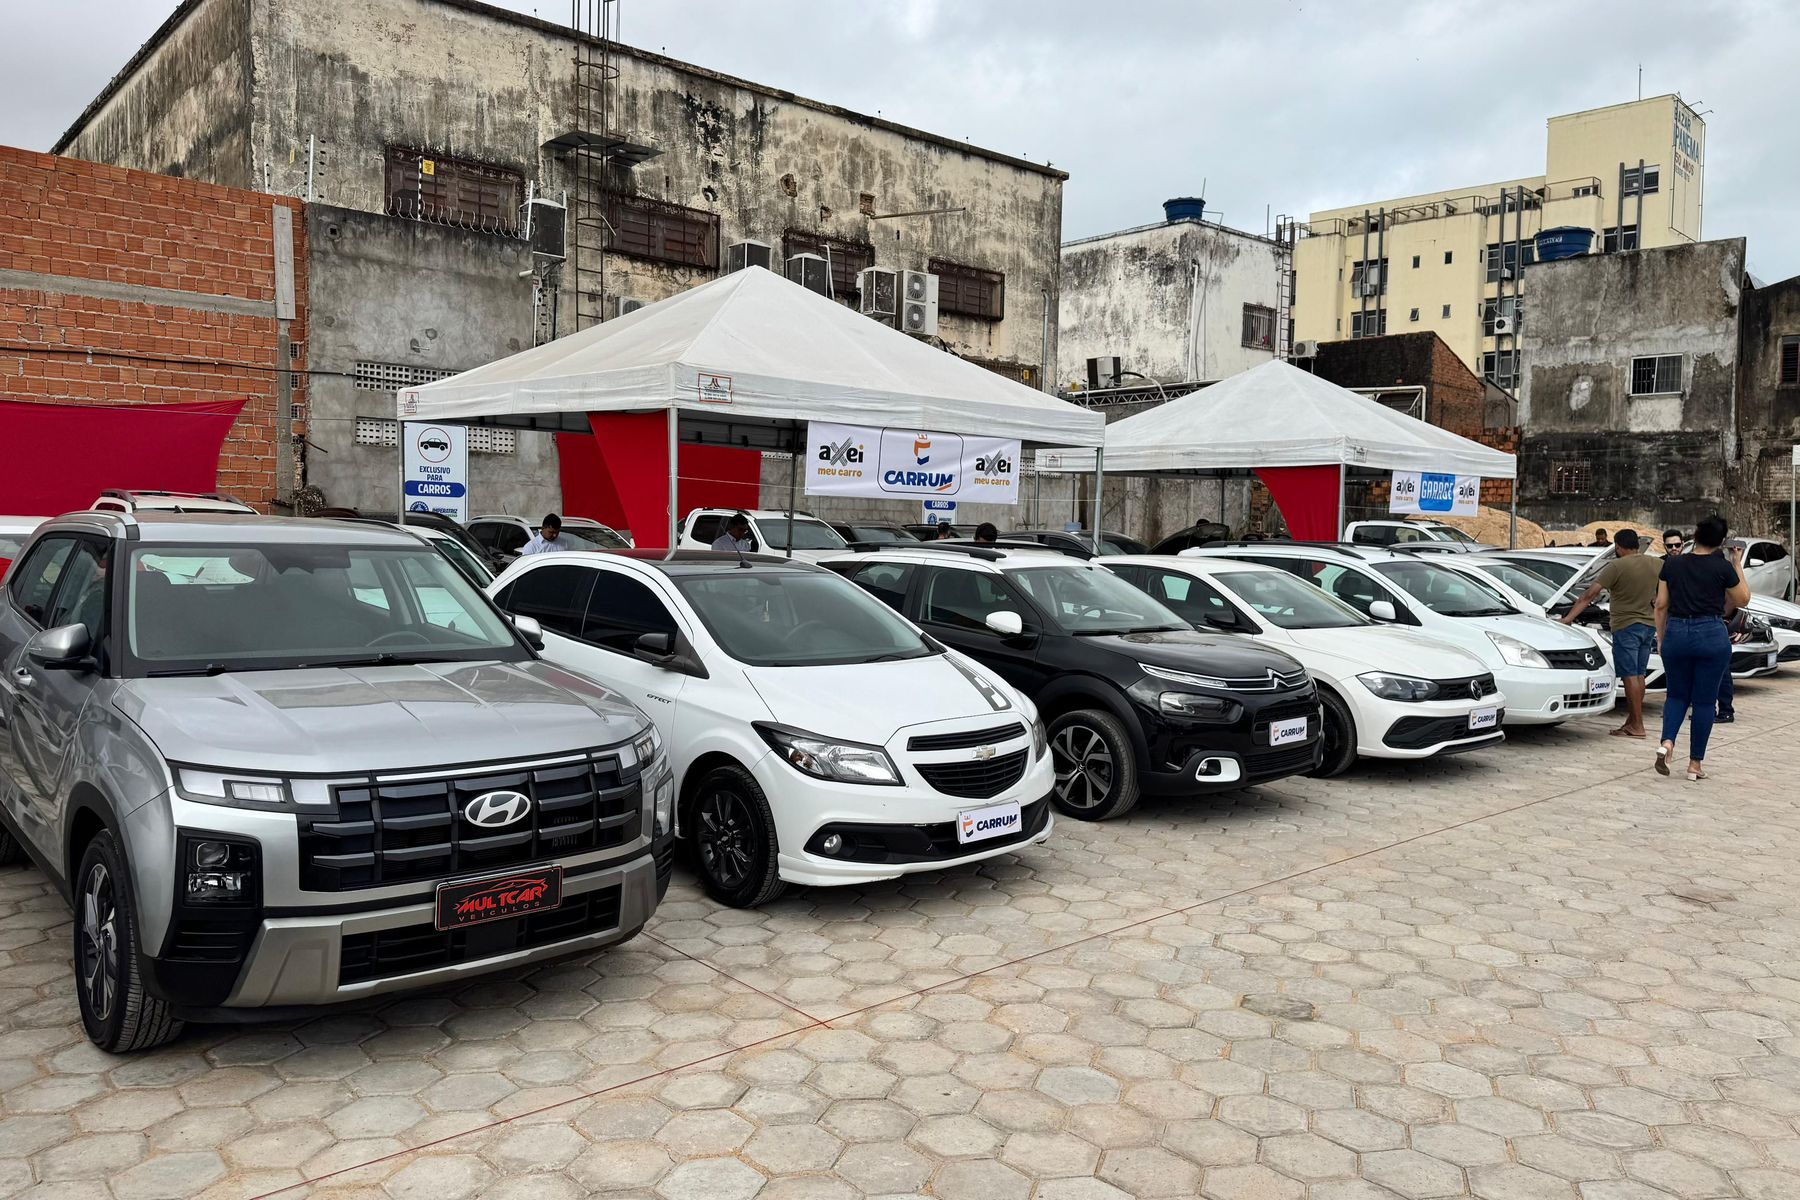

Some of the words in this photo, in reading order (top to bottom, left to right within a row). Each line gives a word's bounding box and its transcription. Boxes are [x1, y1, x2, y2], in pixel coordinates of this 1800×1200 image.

[419, 465, 451, 474] EXCLUSIVO
[817, 468, 836, 476] meu
[838, 469, 862, 478] carro
[883, 470, 953, 487] CARRUM
[974, 477, 989, 485] meu
[990, 478, 1010, 486] carro
[417, 483, 451, 495] CARROS
[1421, 480, 1454, 500] GARAGE
[1280, 726, 1305, 737] CARRUM
[976, 813, 1018, 832] CARRUM
[457, 883, 548, 914] MULTCAR
[459, 901, 540, 922] VEICULOS
